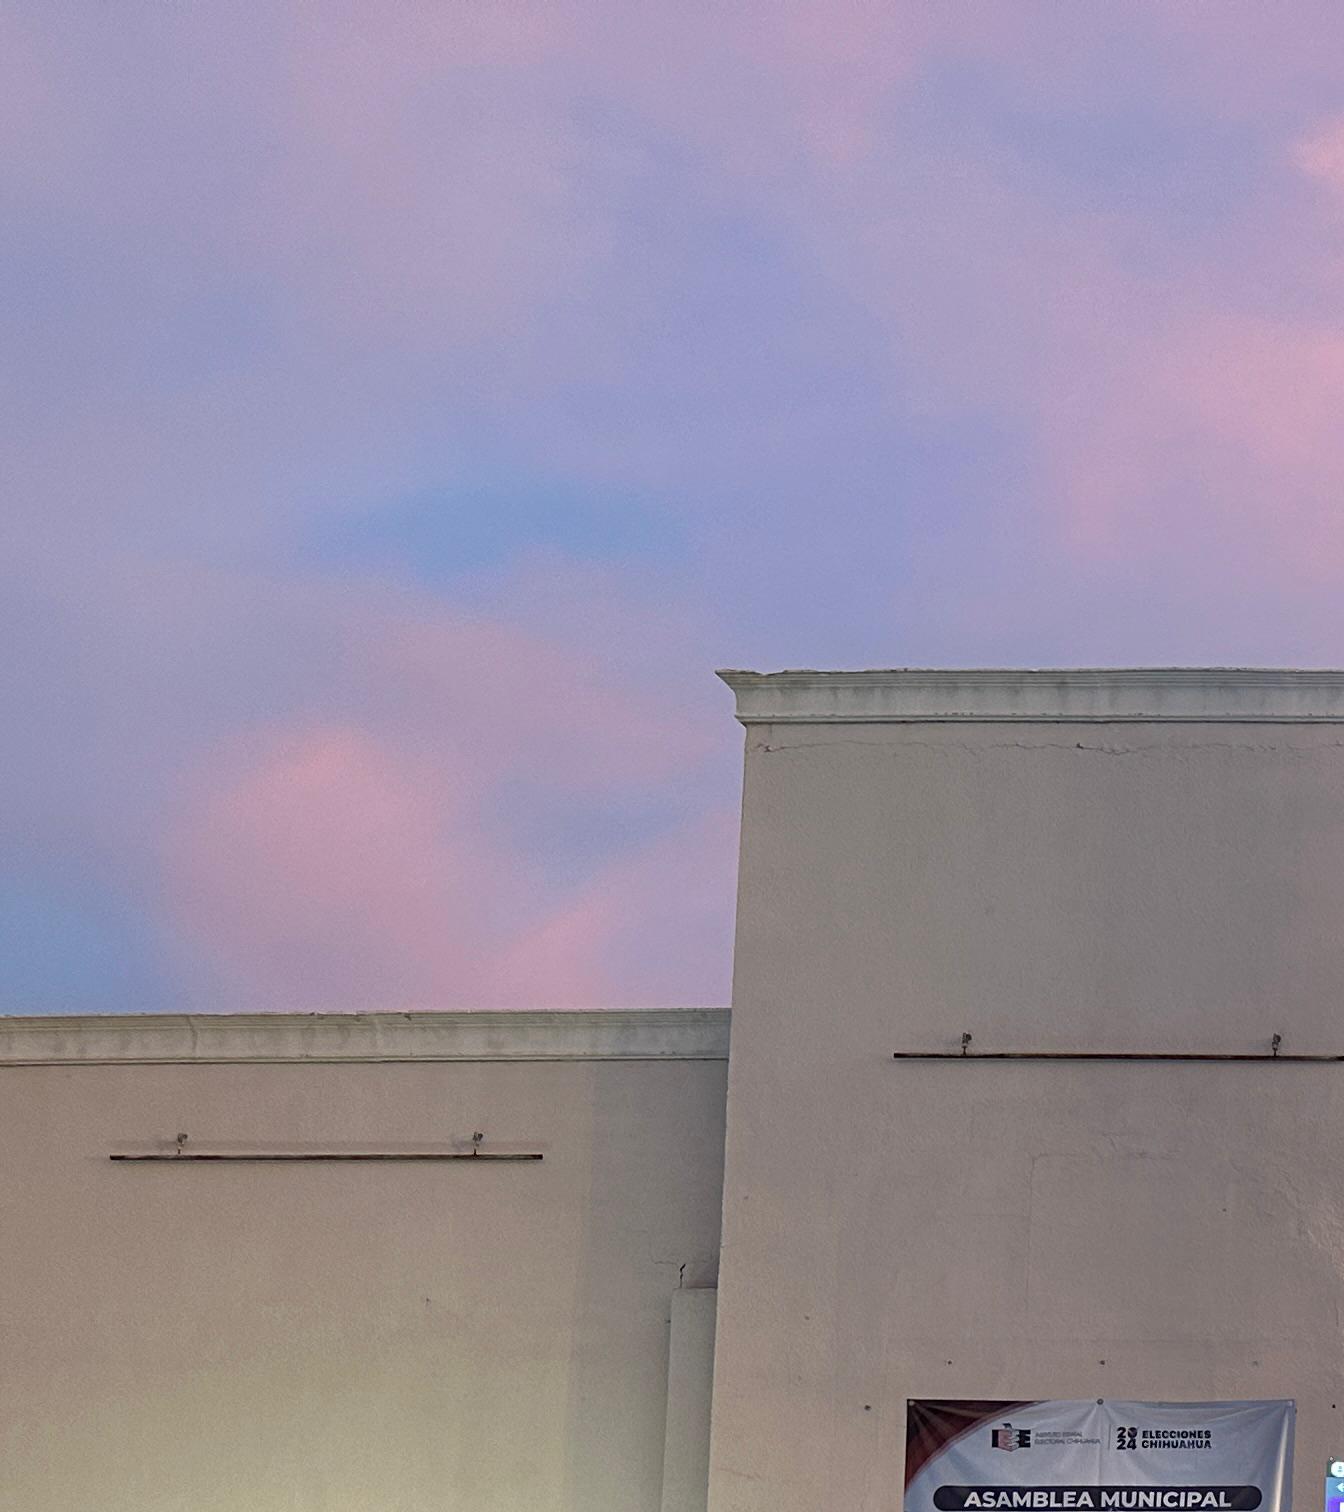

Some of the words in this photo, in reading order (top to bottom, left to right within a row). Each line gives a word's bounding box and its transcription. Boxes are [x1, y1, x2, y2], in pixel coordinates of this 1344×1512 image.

[1141, 1429, 1212, 1440] ELECCIONES
[1116, 1438, 1137, 1450] 24
[1141, 1439, 1212, 1449] CHIHUAHUA
[963, 1490, 1095, 1509] ASAMBLEA
[1100, 1490, 1232, 1509] MUNICIPAL
